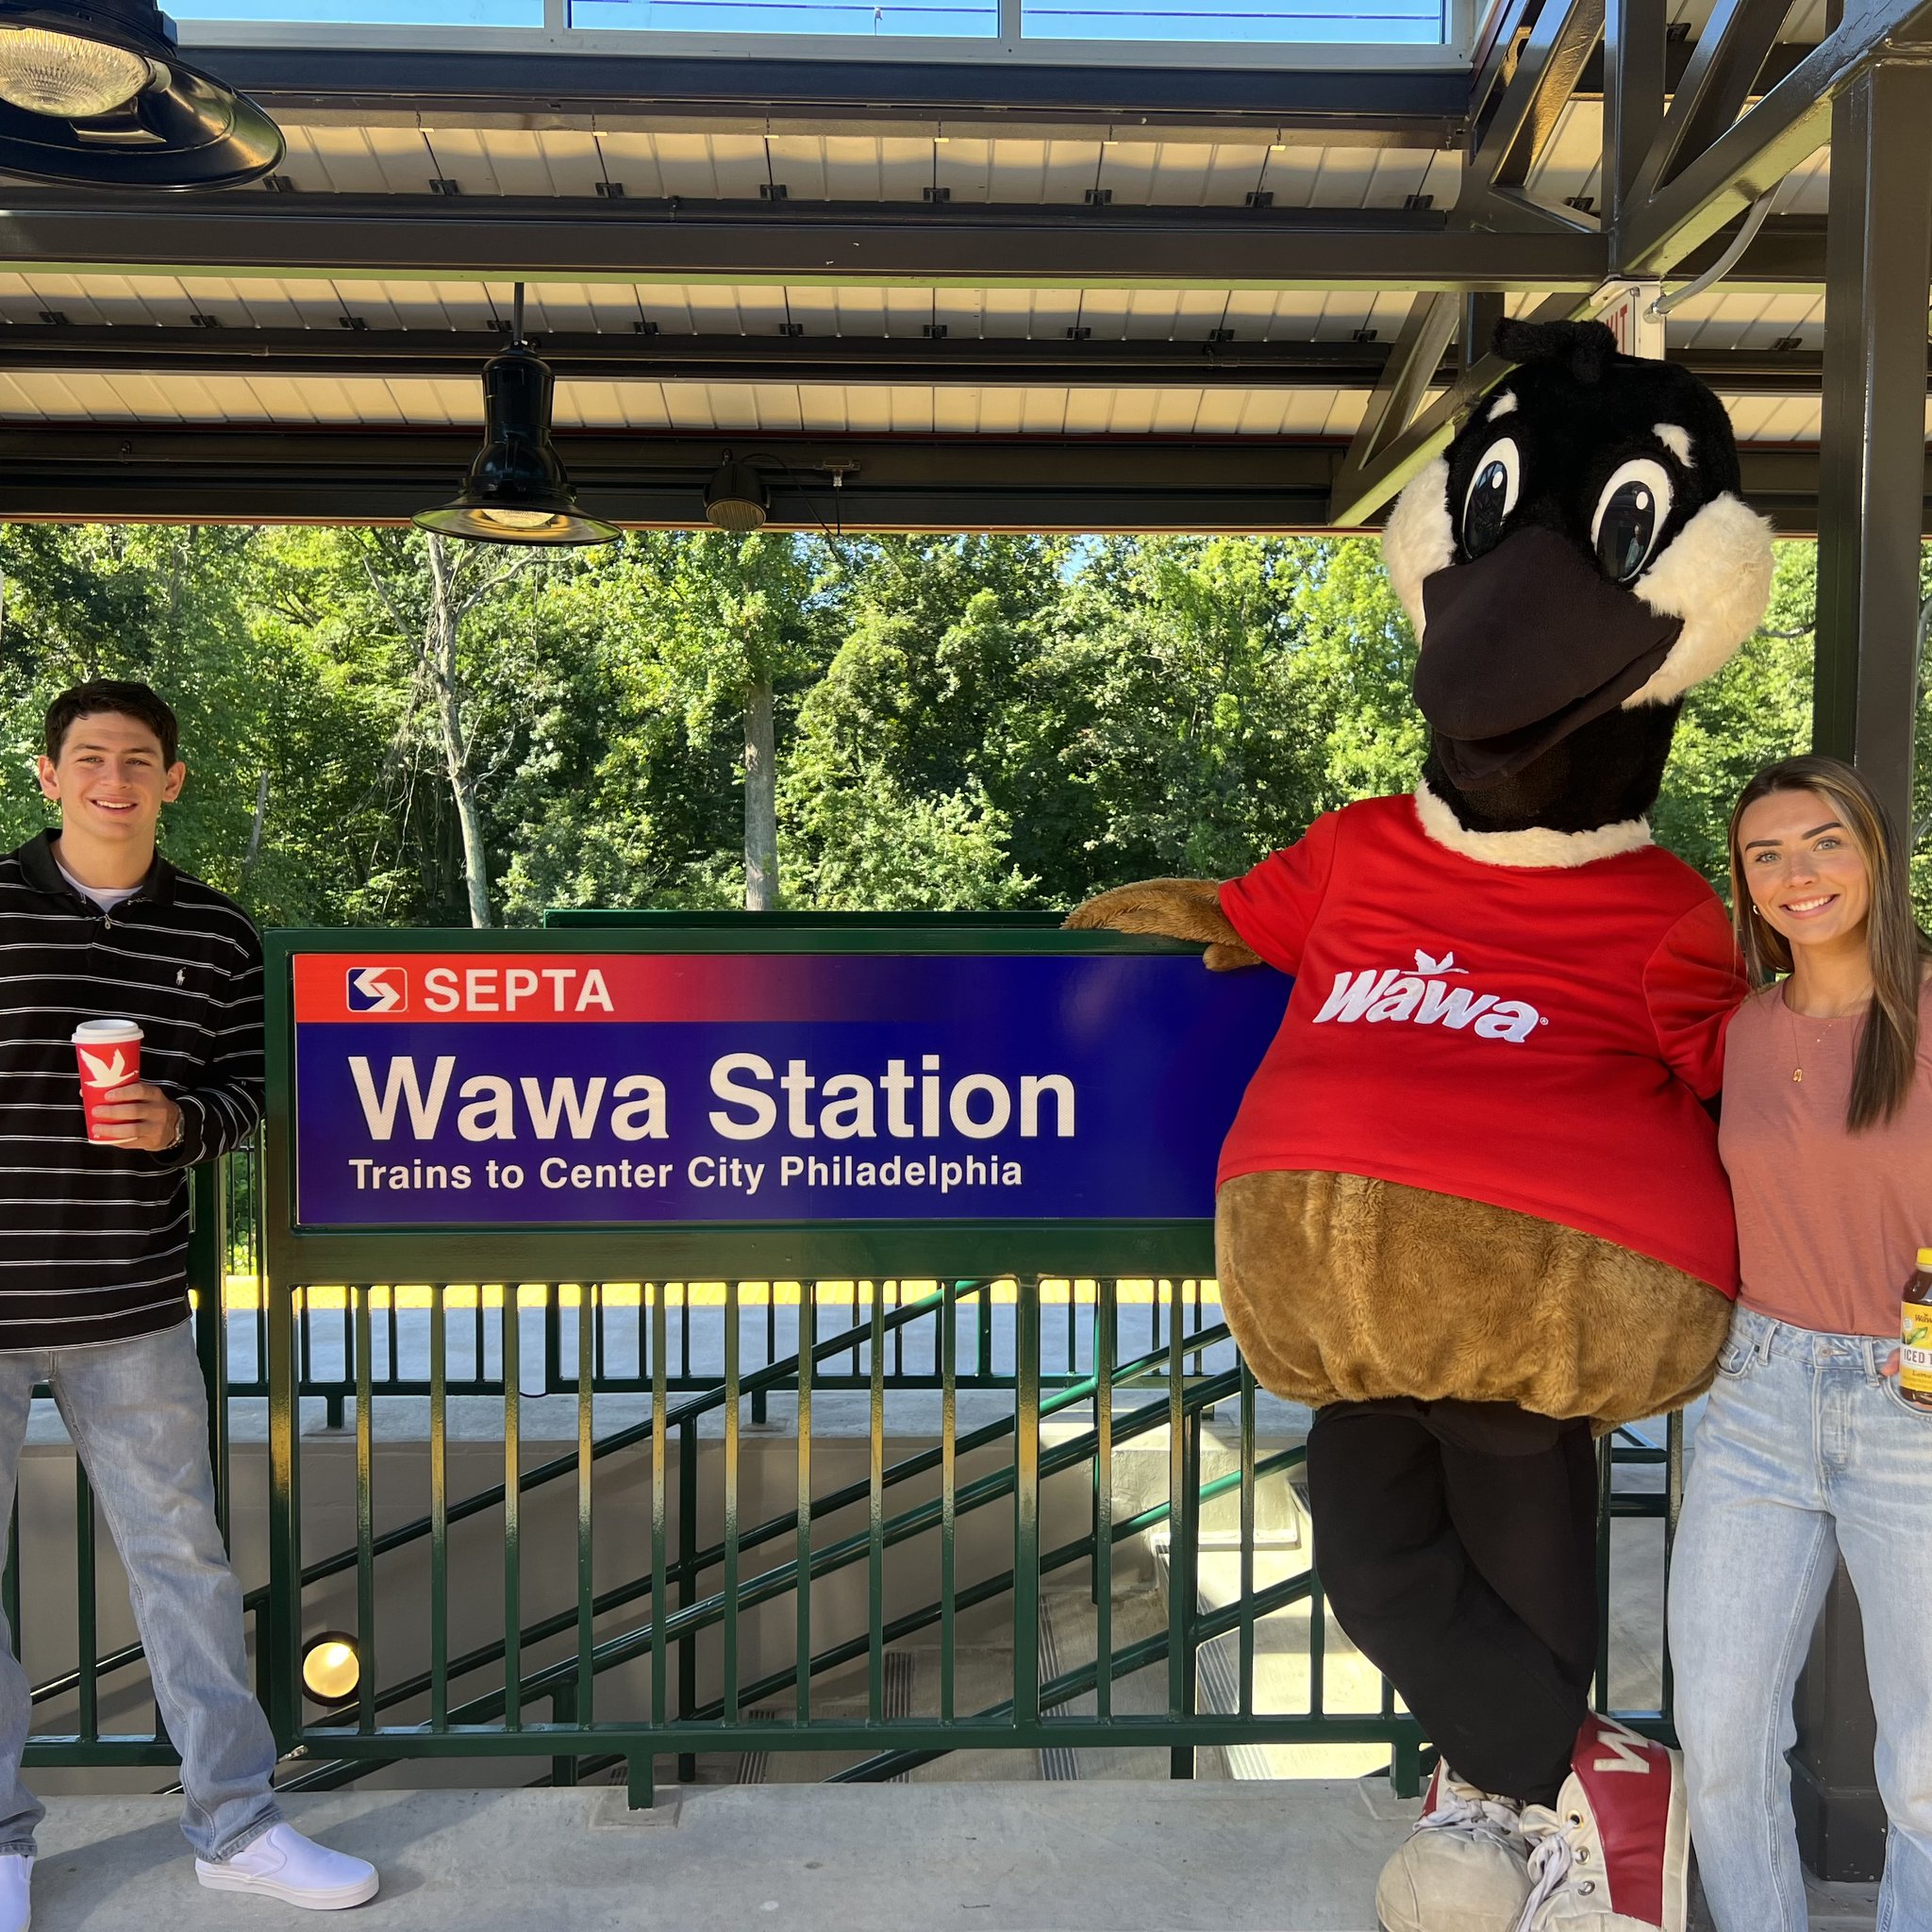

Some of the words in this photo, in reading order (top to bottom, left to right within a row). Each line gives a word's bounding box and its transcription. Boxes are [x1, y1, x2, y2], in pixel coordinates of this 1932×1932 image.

[424, 968, 614, 1013] SEPTA
[1312, 969, 1540, 1043] Wawa
[347, 1055, 669, 1141] Wawa
[708, 1053, 1075, 1141] Station
[348, 1158, 472, 1190] Trains
[485, 1159, 525, 1189] to
[540, 1157, 674, 1190] Center
[688, 1155, 765, 1196] City
[779, 1155, 1023, 1194] Philadelphia
[1903, 1349, 1925, 1364] ICED
[1593, 1712, 1650, 1774] W
